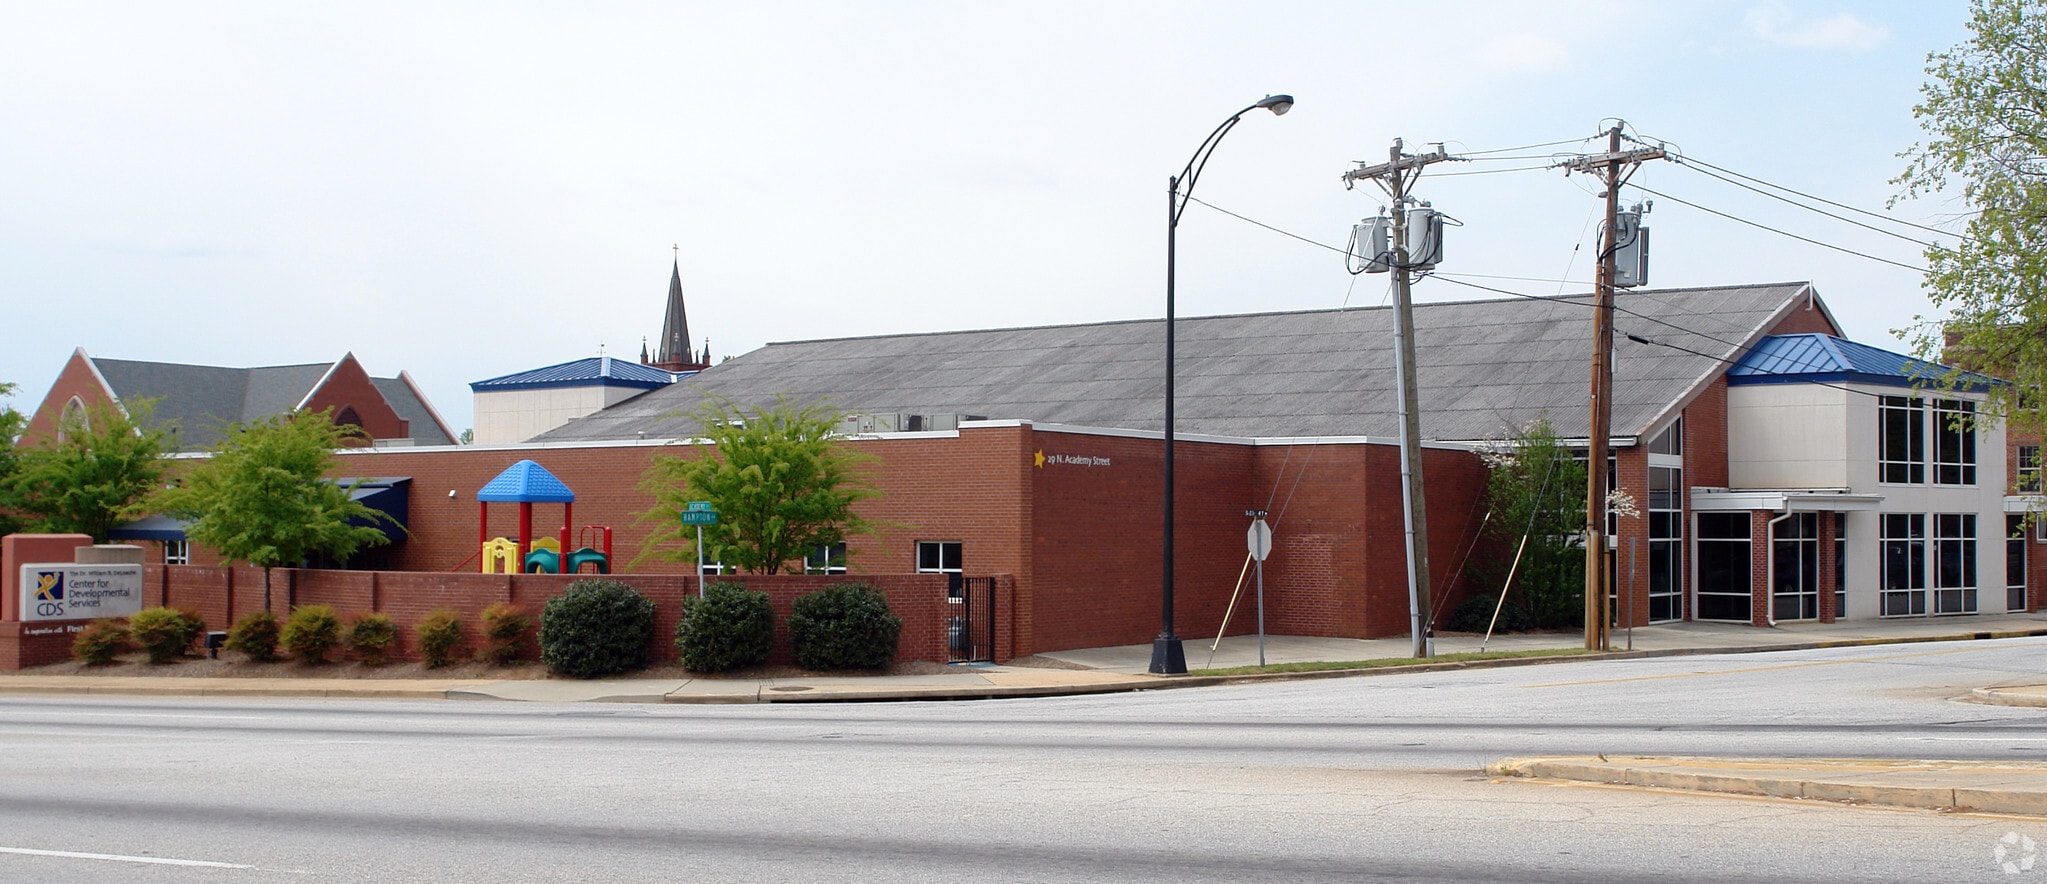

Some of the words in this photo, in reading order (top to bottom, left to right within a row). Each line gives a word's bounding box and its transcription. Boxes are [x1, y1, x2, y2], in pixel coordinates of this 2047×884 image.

[1056, 454, 1064, 464] N.
[1064, 454, 1092, 467] Academy
[1092, 456, 1111, 466] Street
[683, 513, 710, 521] HAMPTON
[68, 580, 96, 589] Center
[96, 579, 109, 588] for
[69, 588, 130, 599] Developmental
[68, 599, 101, 608] Services
[37, 602, 64, 616] CDS
[67, 625, 84, 633] First
